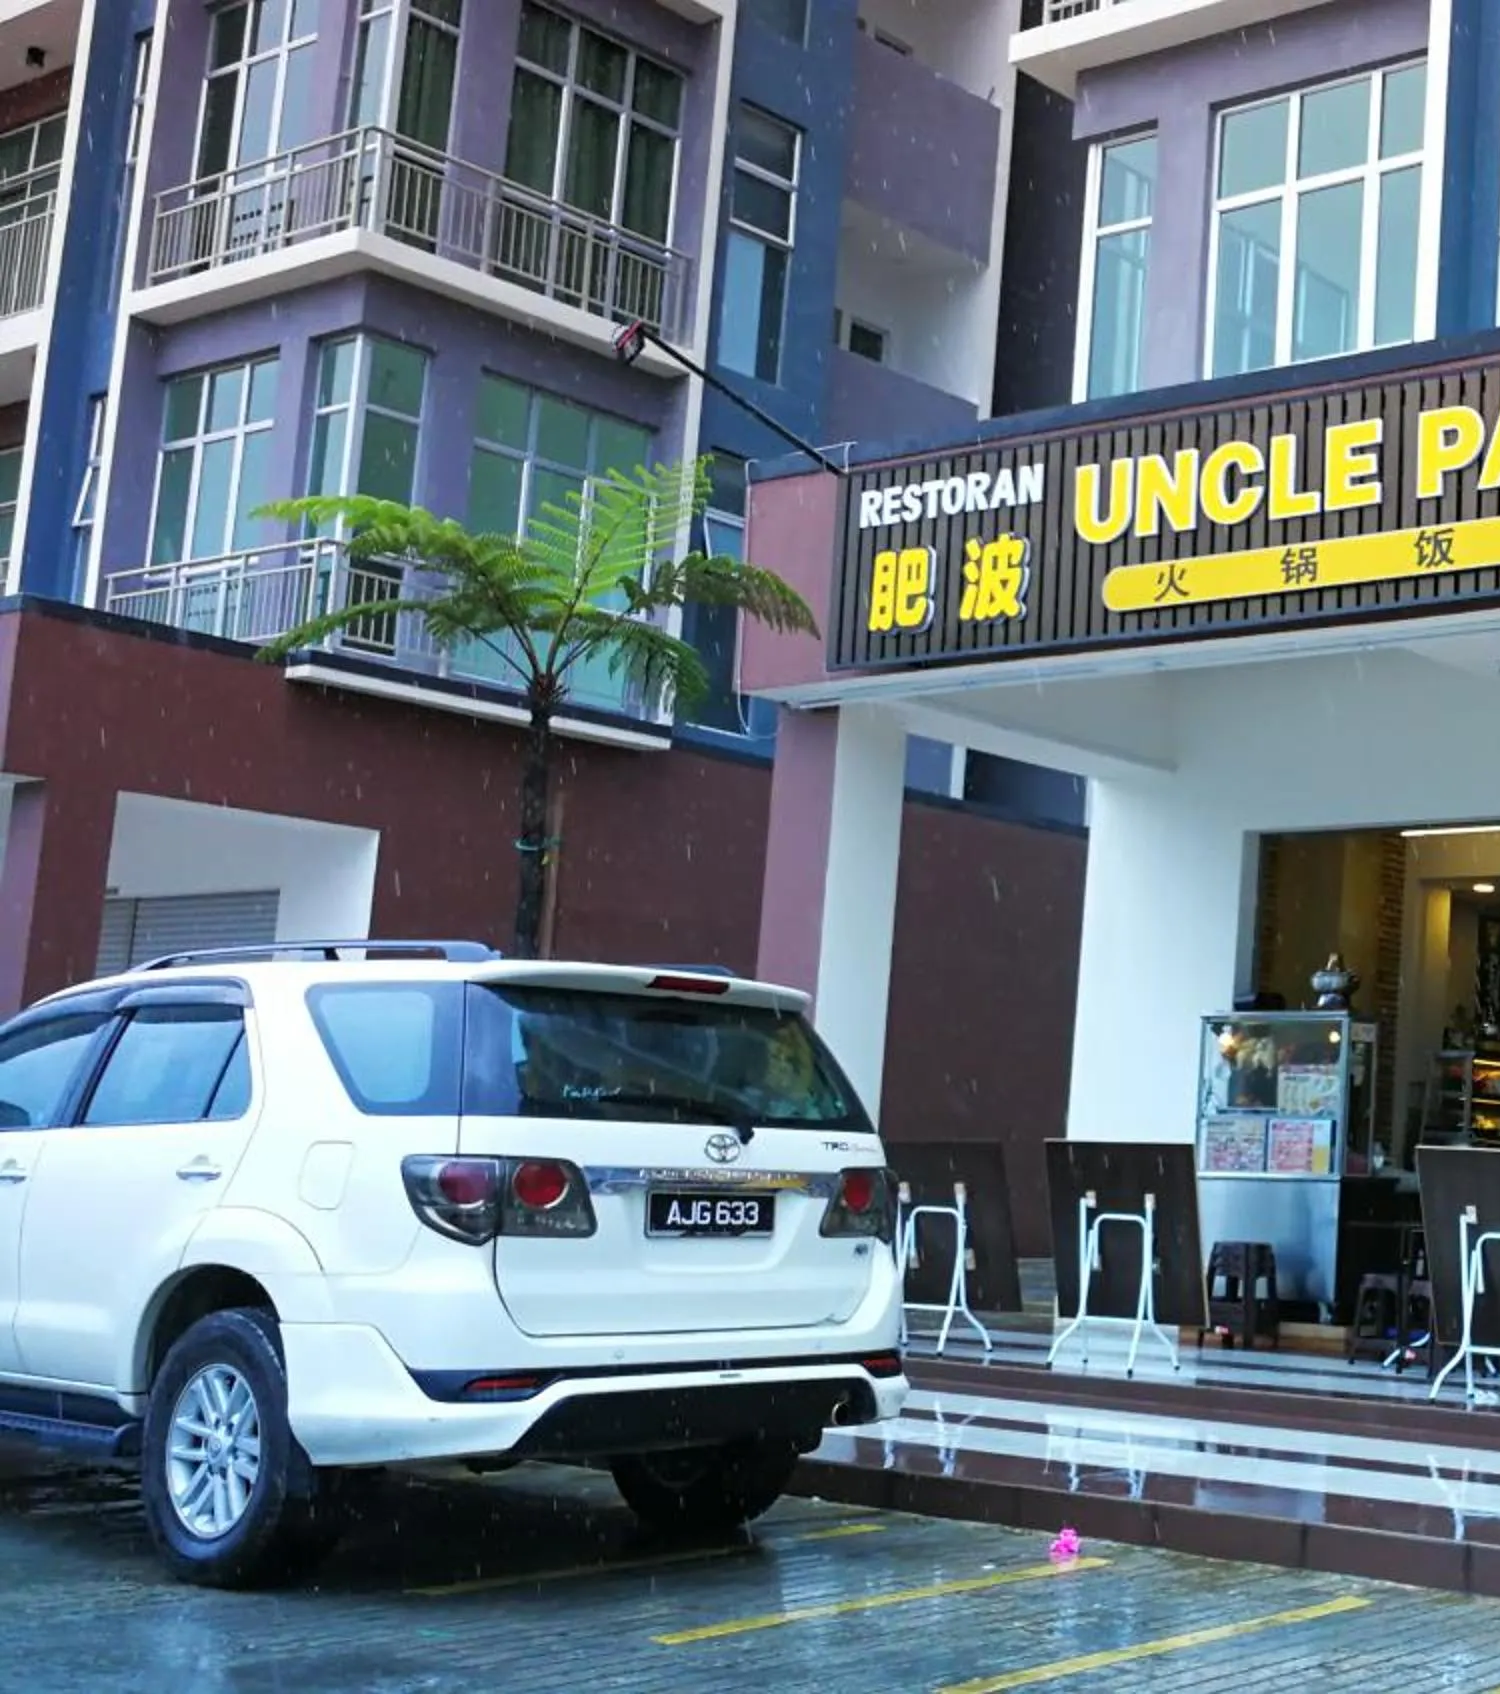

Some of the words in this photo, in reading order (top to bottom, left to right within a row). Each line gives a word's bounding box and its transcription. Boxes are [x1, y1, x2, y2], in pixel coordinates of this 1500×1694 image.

[859, 463, 1045, 529] RESTORAN
[1074, 417, 1383, 545] UNCLE
[868, 532, 1029, 633] 肥波
[666, 1200, 711, 1225] AJG
[715, 1201, 759, 1225] 633
